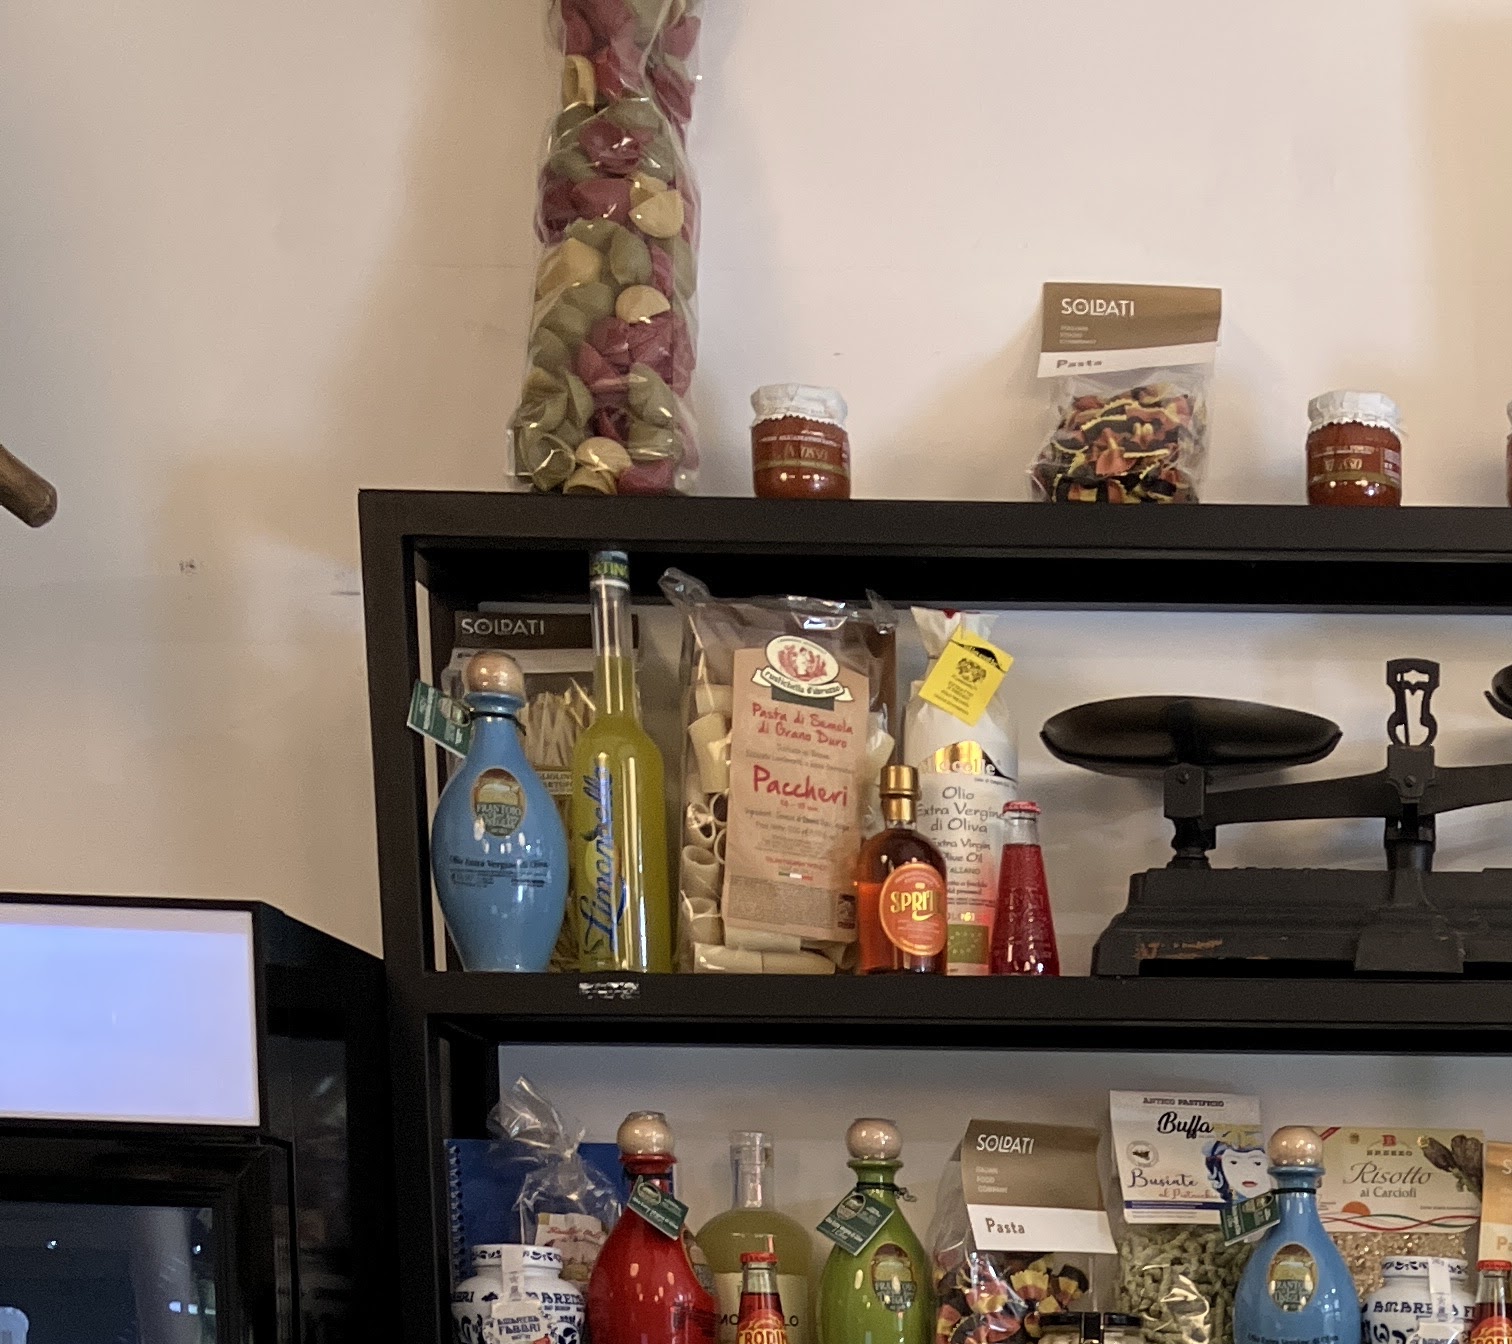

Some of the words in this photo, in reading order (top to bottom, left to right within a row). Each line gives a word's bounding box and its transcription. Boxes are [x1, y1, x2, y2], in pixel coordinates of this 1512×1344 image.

[1061, 298, 1135, 317] SOLDATI
[1056, 359, 1103, 369] Pasta
[461, 618, 546, 637] SOLDATI
[752, 702, 788, 721] Pasta
[793, 711, 805, 725] di
[810, 714, 854, 735] Semola
[757, 721, 769, 734] di
[775, 721, 812, 742] Grano
[816, 730, 848, 749] Duro
[753, 764, 849, 808] Paccheri
[942, 786, 975, 800] Olio
[930, 818, 943, 832] di
[947, 817, 988, 834] Oliva
[1156, 1111, 1215, 1139] Buffa
[976, 1134, 1036, 1155] SOLDATI
[1343, 1160, 1433, 1185] Risotto
[1373, 1187, 1418, 1199] Carciofi
[985, 1217, 1026, 1234] Pasta
